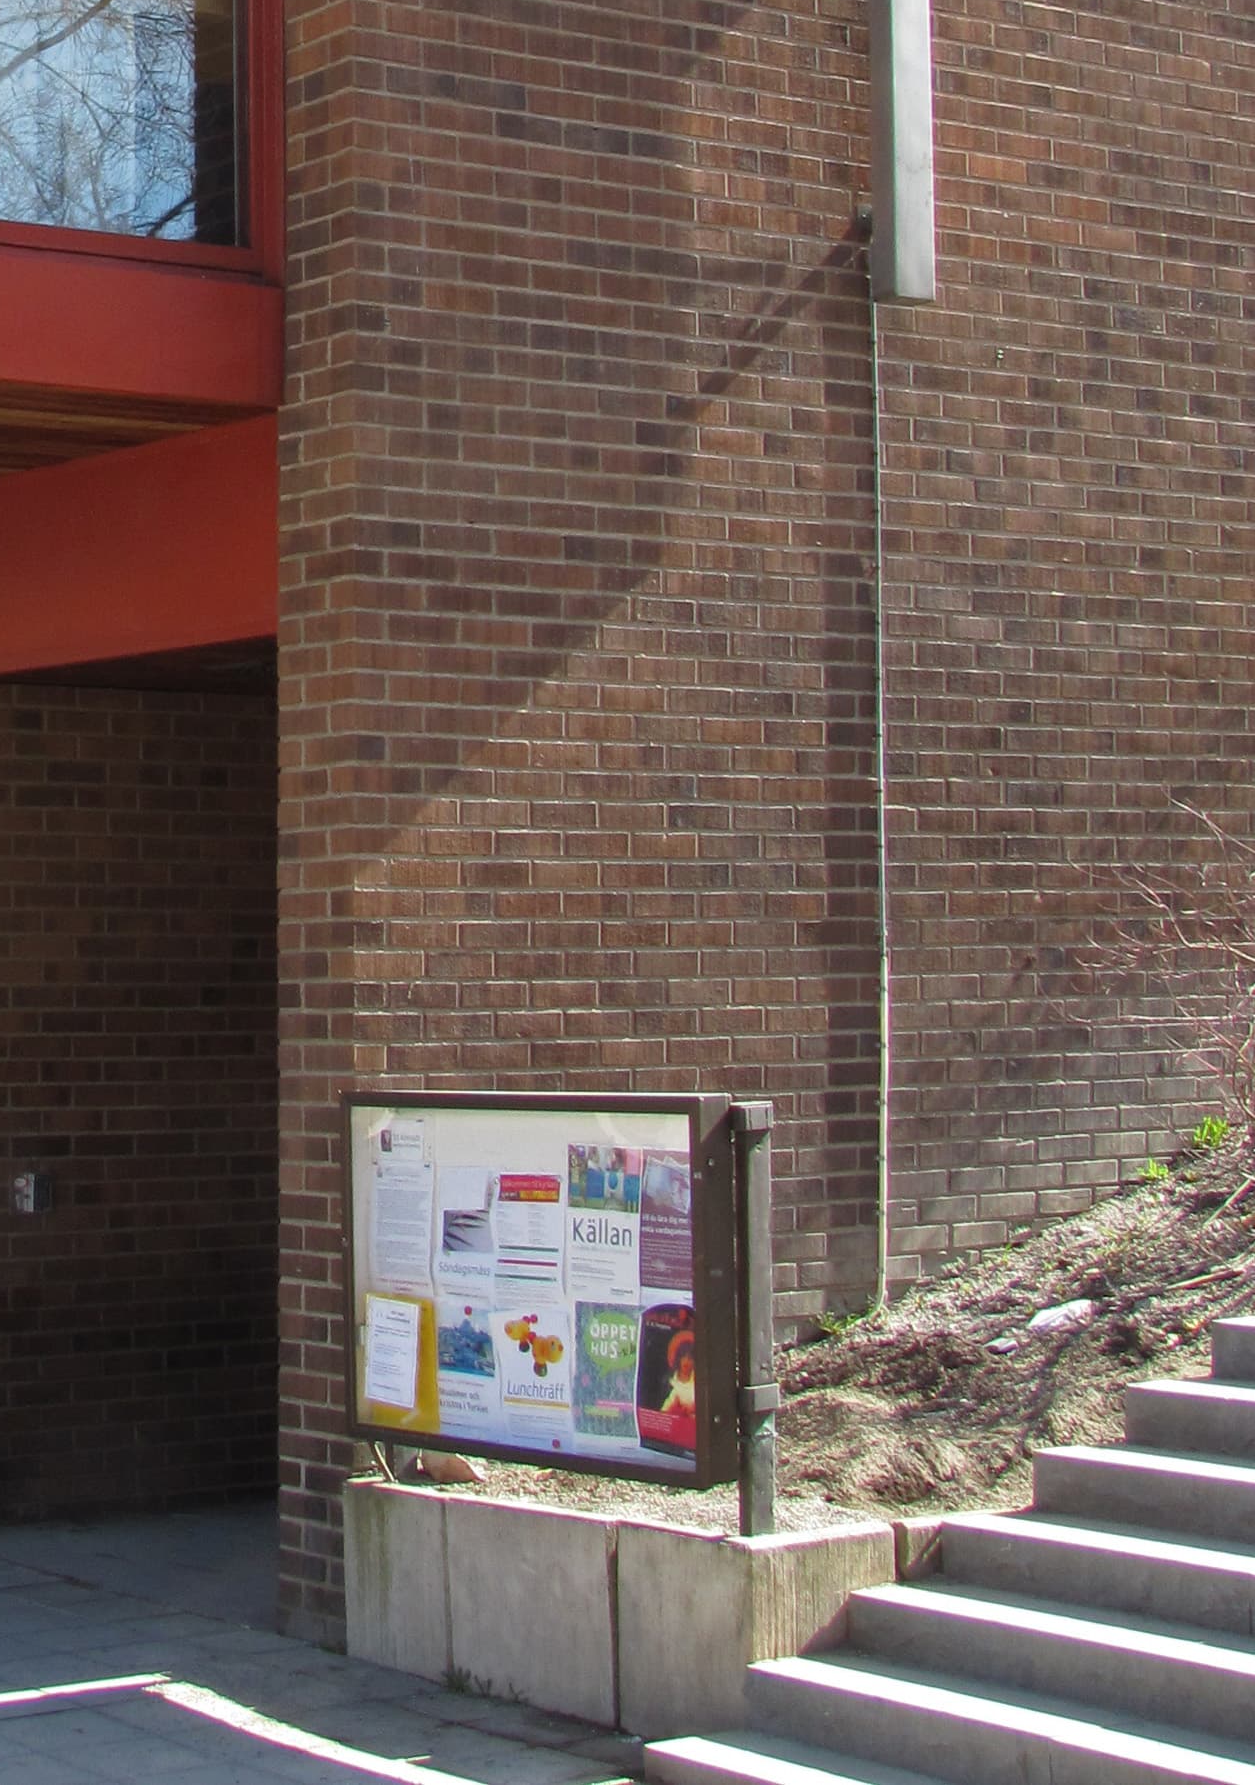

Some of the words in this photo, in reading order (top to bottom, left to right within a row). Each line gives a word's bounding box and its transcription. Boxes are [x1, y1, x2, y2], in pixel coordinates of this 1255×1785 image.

[572, 1217, 632, 1247] Källan
[590, 1317, 636, 1341] ÖPPET
[591, 1340, 619, 1359] HUS
[507, 1378, 565, 1400] Lunchträff
